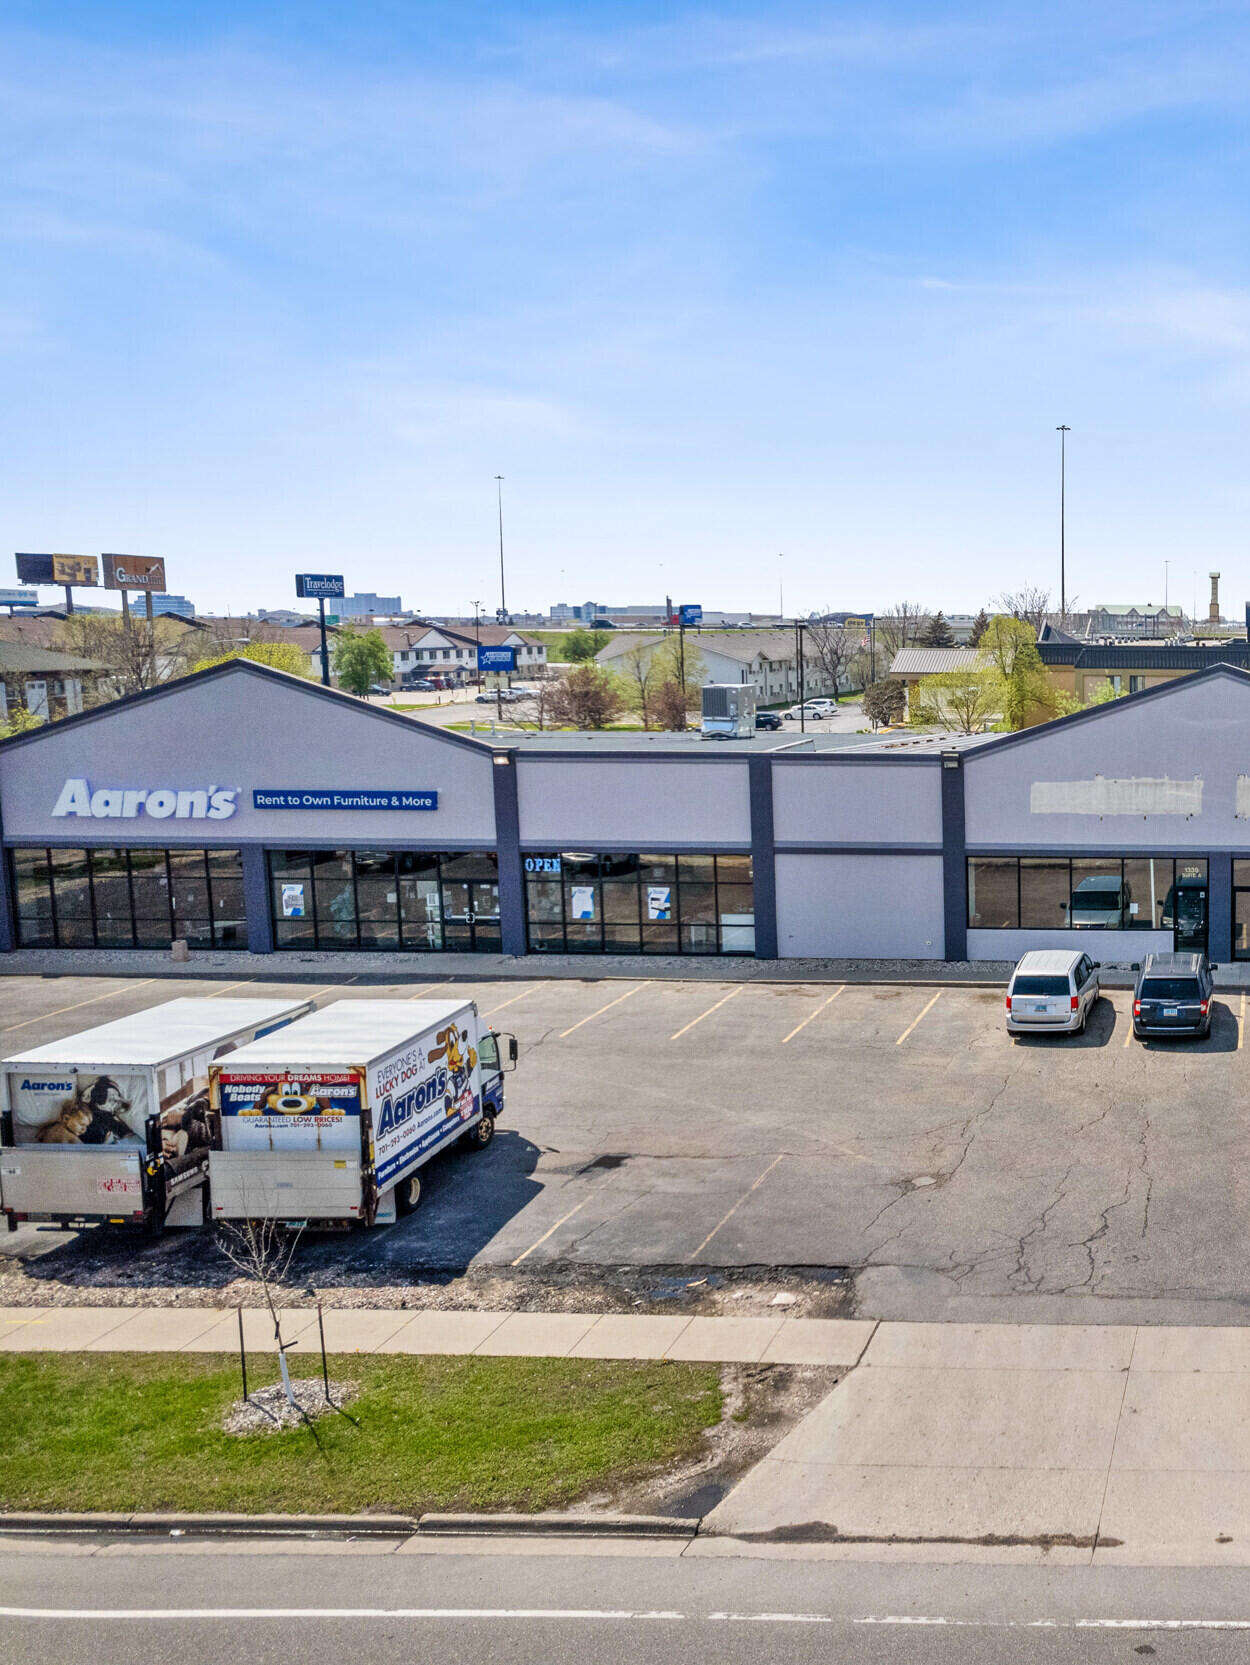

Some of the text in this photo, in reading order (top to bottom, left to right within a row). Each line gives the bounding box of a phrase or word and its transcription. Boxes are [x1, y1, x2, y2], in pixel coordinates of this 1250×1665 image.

[305, 577, 343, 592] Travelodge
[51, 779, 237, 819] Aaron's
[256, 795, 432, 807] Rent to Own Furniture & More
[525, 858, 561, 872] OPEN
[377, 1047, 423, 1084] EVERYONE'S A
[376, 1057, 426, 1099] LUCKY DOG AT
[21, 1079, 73, 1091] Aaron's
[224, 1084, 266, 1094] Nobody
[310, 1084, 357, 1097] Aaron's
[229, 1093, 261, 1102] Beats
[377, 1067, 448, 1140] Aaron's
[242, 1116, 291, 1124] GUARANTEED
